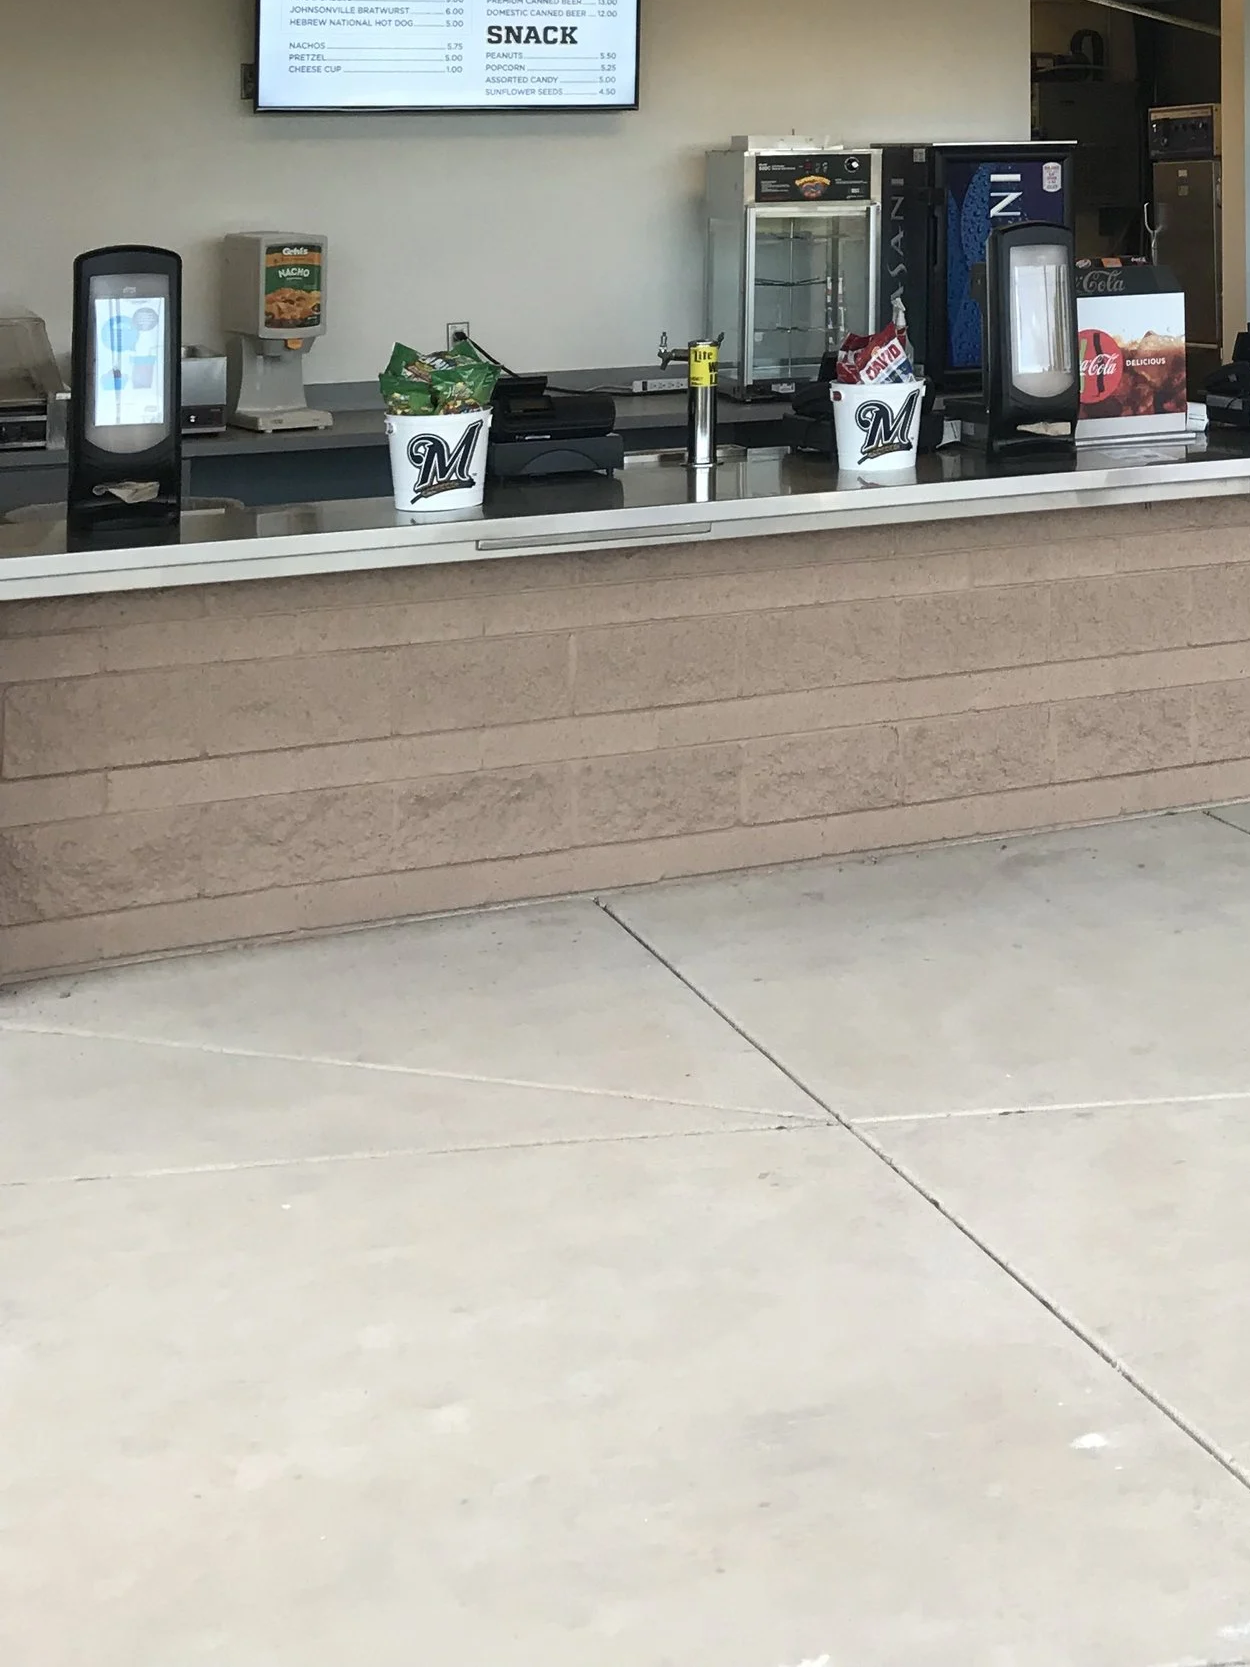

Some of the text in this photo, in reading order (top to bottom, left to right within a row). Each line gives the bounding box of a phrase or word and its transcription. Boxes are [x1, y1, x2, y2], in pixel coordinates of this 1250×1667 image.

[290, 6, 464, 16] JOHNSONVILLE BRATWURST 6.00
[598, 10, 618, 18] 12.00
[290, 19, 327, 27] HEBREW
[329, 19, 372, 27] NATIONAL
[394, 20, 414, 28] DOG
[446, 20, 464, 28] 5.00
[487, 25, 578, 45] SNACK
[289, 42, 326, 50] NACHOS
[289, 54, 463, 62] PRETZEL 5.00
[486, 52, 616, 60] PEANUTS 5.50
[288, 66, 463, 74] CHEESE CUP 1.00
[486, 64, 616, 72] POPCORN 5.25
[485, 76, 528, 84] ASSORTED
[530, 76, 559, 84] CANDY
[485, 88, 616, 96] SUNFLOWER SEEDS 4.50
[887, 178, 908, 300] SANI
[278, 268, 310, 278] NACHO
[694, 350, 714, 363] Lite
[866, 343, 901, 381] DAVID
[1080, 352, 1119, 376] a-Cola
[1126, 358, 1166, 367] DELICIOUS
[855, 388, 920, 455] M
[406, 419, 483, 493] M
